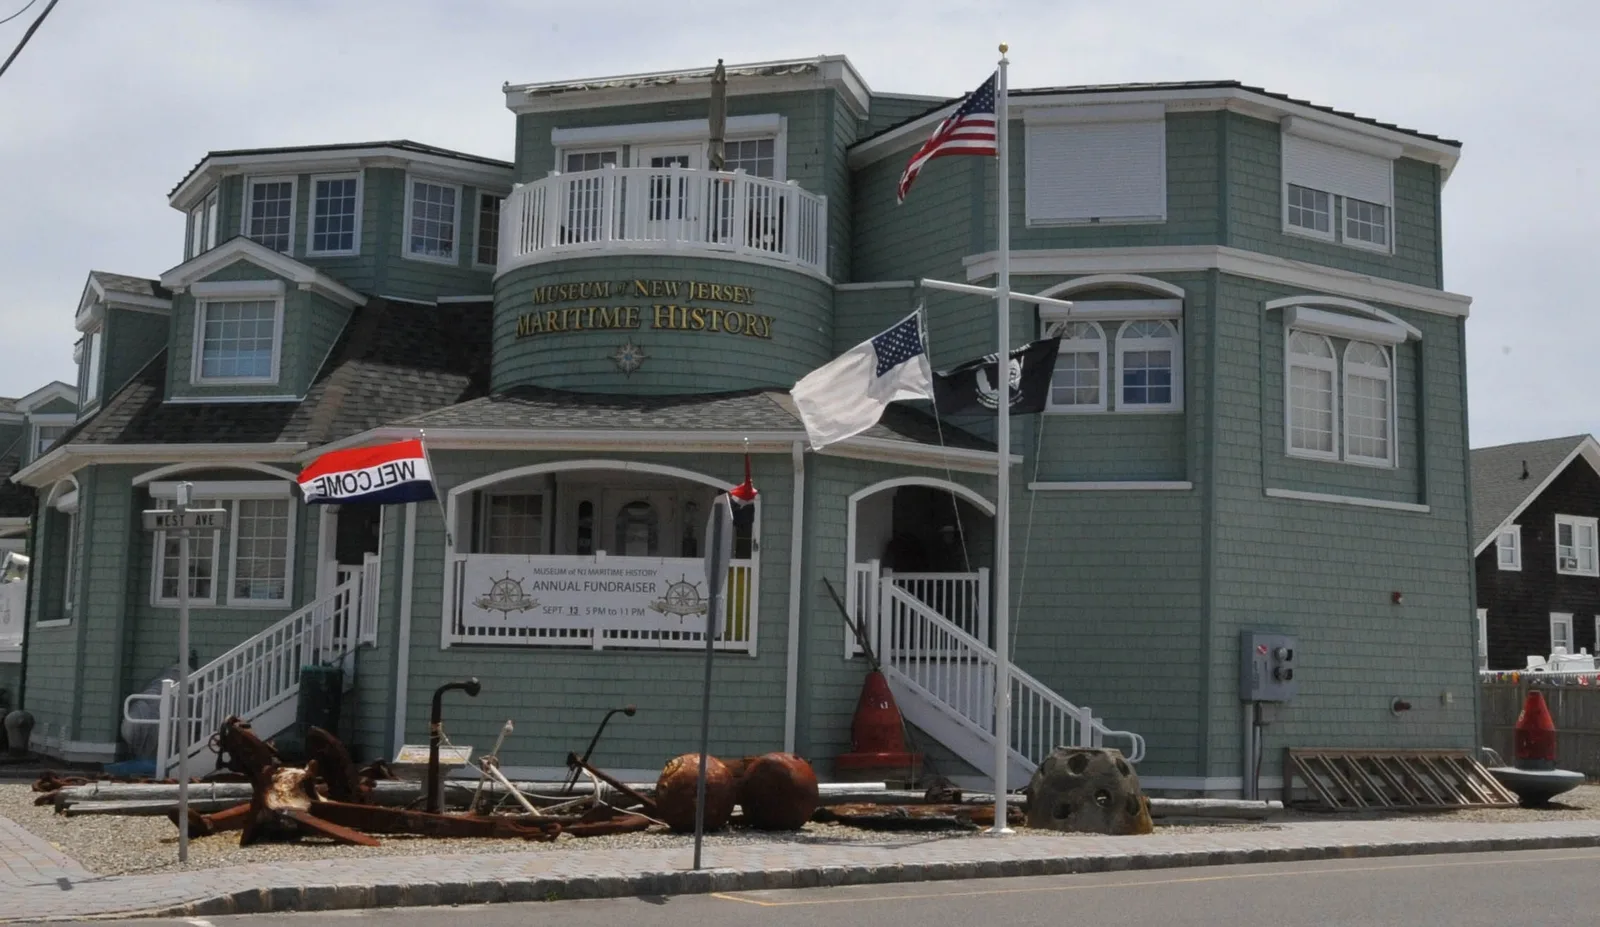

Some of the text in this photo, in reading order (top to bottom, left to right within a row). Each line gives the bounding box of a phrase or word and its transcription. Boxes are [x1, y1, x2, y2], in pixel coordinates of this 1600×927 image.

[532, 281, 611, 305] MUSEUM
[633, 279, 682, 298] NEW
[685, 280, 756, 305] JERSEY
[515, 303, 776, 340] MARITIME HISTORY
[156, 514, 215, 527] WEST AVE
[533, 568, 567, 576] MUSEUM
[588, 569, 624, 577] MARITIME
[625, 569, 658, 578] HISTORY
[532, 581, 656, 593] ANNUAL FUNDRAISER
[585, 607, 591, 616] 5
[592, 607, 606, 616] PM
[608, 607, 618, 617] to
[631, 608, 646, 617] PM
